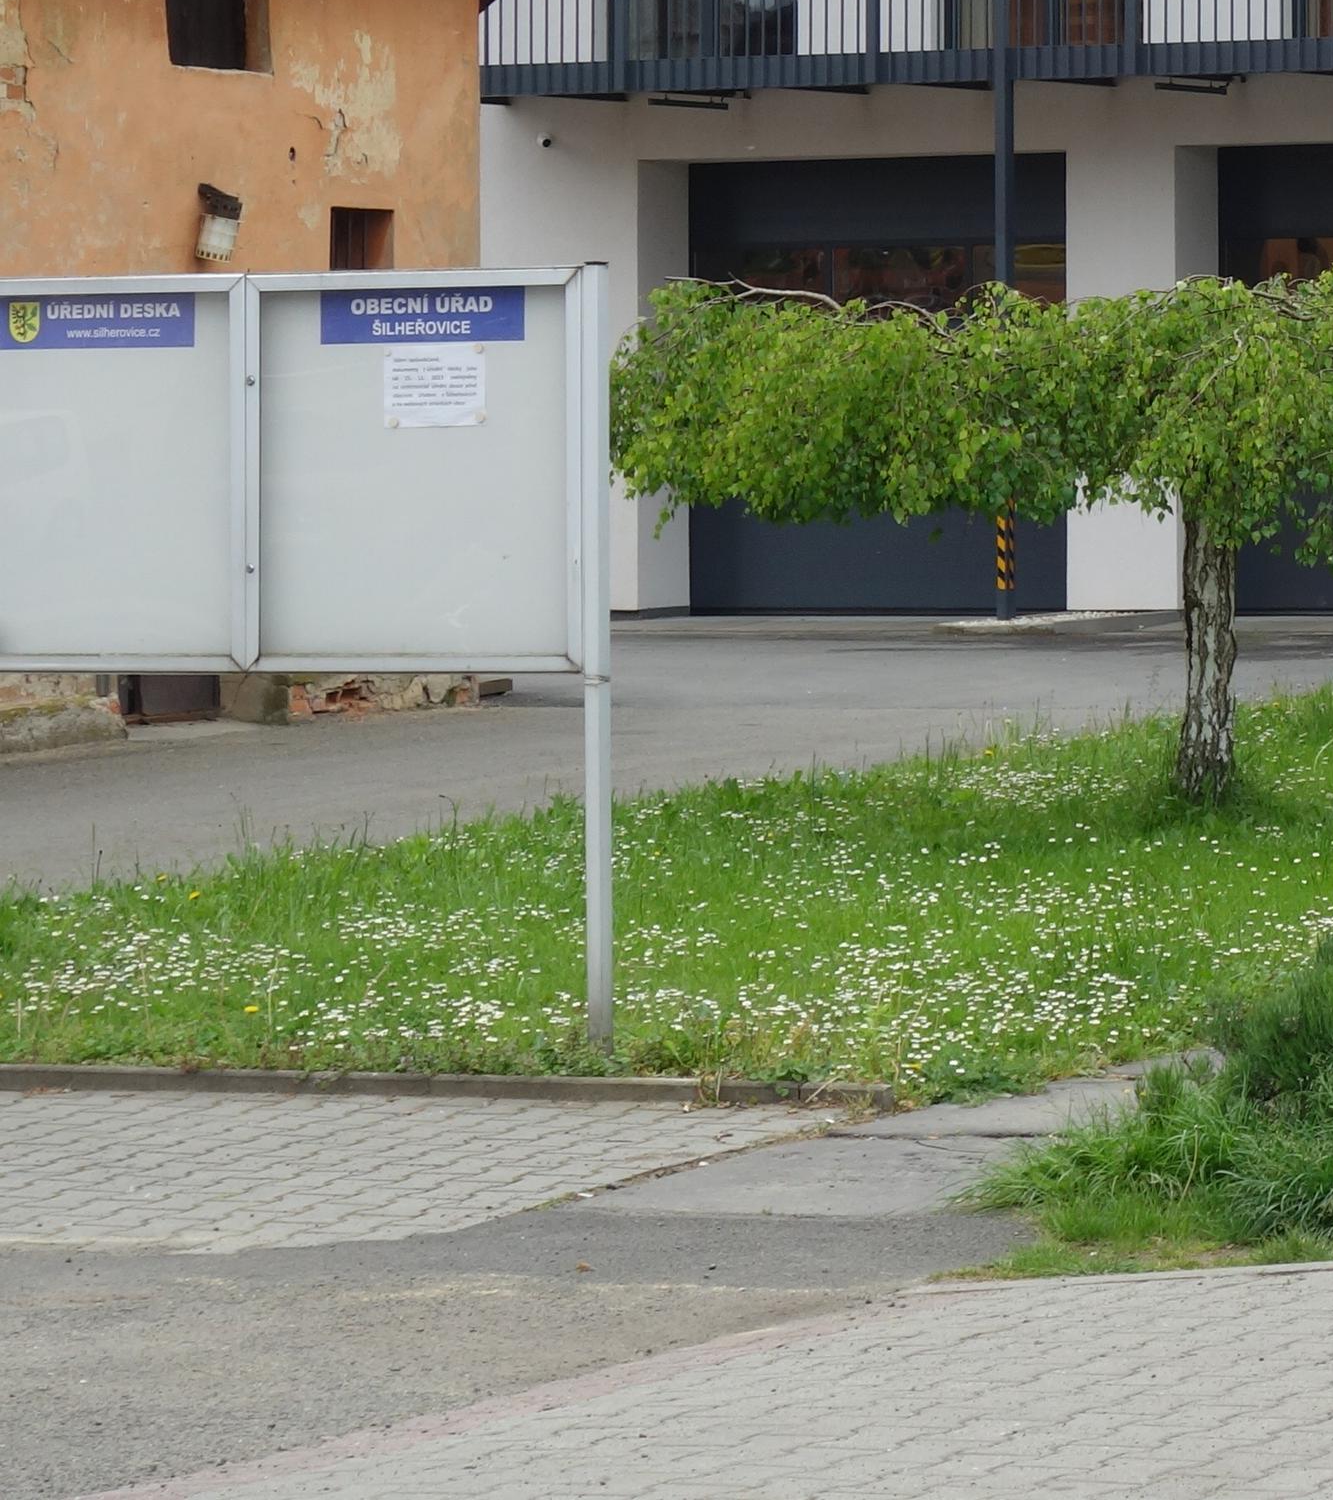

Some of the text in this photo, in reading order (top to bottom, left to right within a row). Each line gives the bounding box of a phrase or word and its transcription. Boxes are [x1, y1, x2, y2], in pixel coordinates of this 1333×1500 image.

[46, 301, 181, 319] ÚŘEDNÍ DESKA
[350, 293, 493, 316] OBECNÍ ÚŘAD
[66, 326, 160, 339] www.silherovice.cz
[372, 318, 471, 336] ŠILHEŘOVICE
